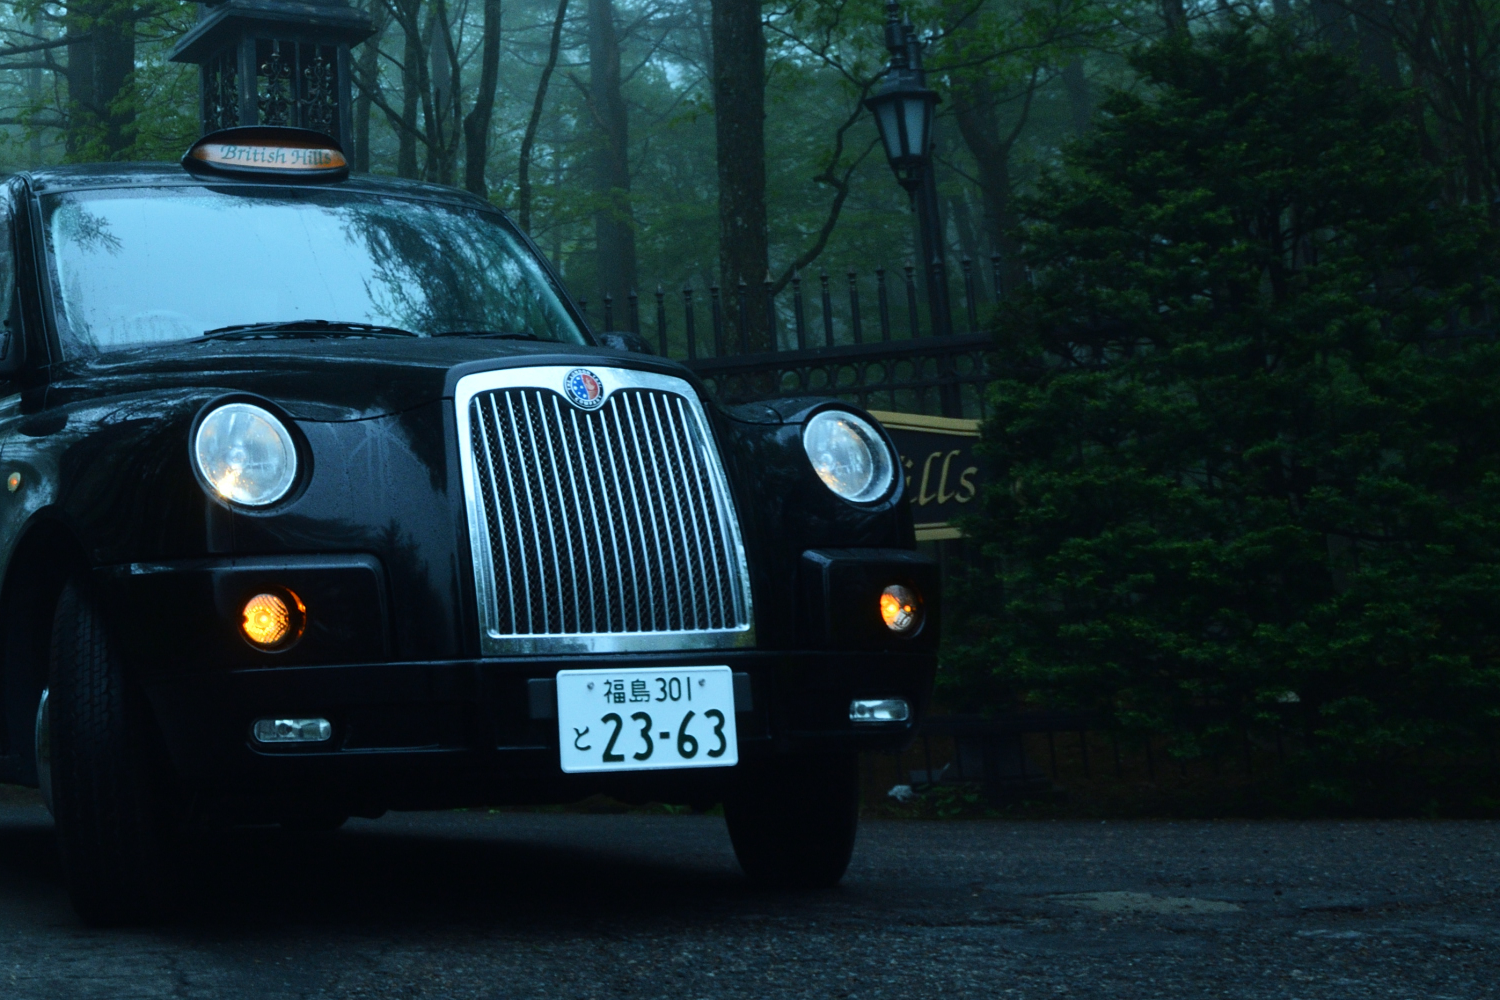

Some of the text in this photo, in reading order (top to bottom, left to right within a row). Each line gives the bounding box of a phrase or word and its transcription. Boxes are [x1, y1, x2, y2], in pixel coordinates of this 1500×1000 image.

[220, 144, 332, 166] British Hills
[603, 676, 692, 704] 福島 301
[573, 708, 727, 763] と 23-63
